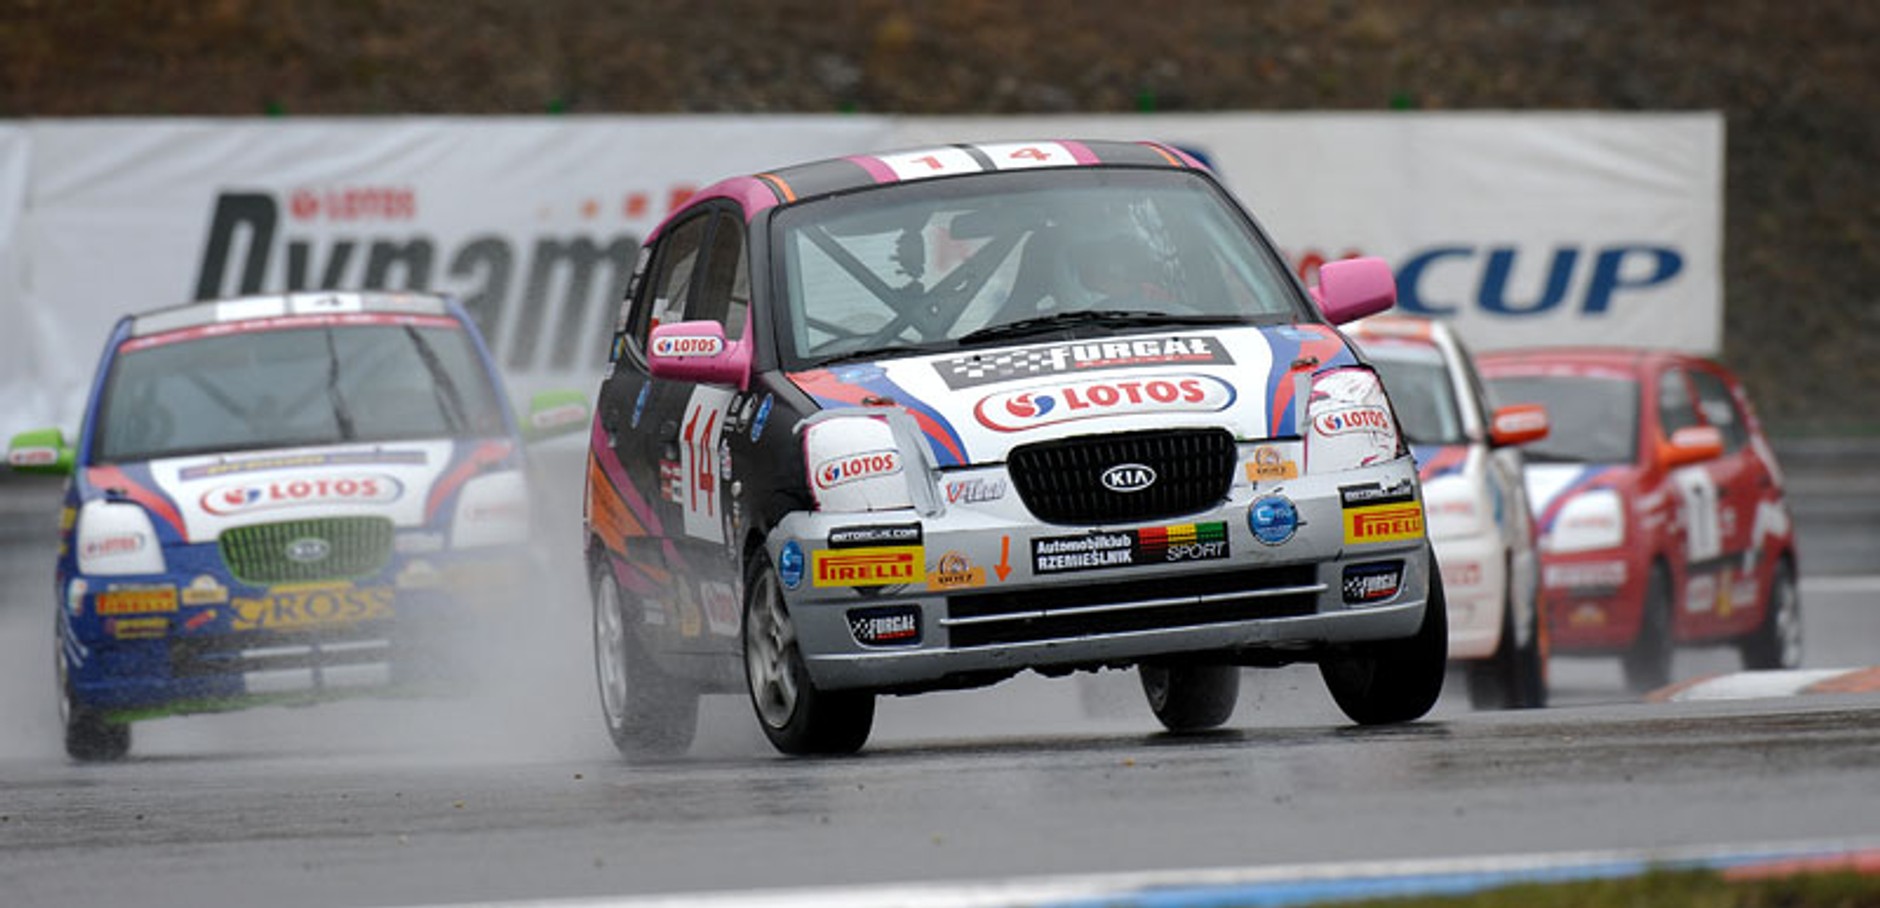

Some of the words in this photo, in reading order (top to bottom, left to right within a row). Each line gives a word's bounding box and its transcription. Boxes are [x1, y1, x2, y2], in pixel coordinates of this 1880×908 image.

[909, 156, 944, 170] 1
[1396, 244, 1684, 315] CUP
[673, 339, 717, 354] LOTOS
[1061, 379, 1206, 411] LOTOS
[1342, 408, 1390, 430] LOTOS
[684, 403, 719, 518] 14
[842, 453, 896, 477] LOTOS
[1111, 470, 1149, 486] KIA
[269, 479, 380, 500] LOTOS
[1036, 533, 1132, 555] Automobilklub
[1165, 541, 1227, 562] SPORT
[818, 552, 914, 581] PIRELLI
[1036, 549, 1133, 571] RZEMIEŚLNIK
